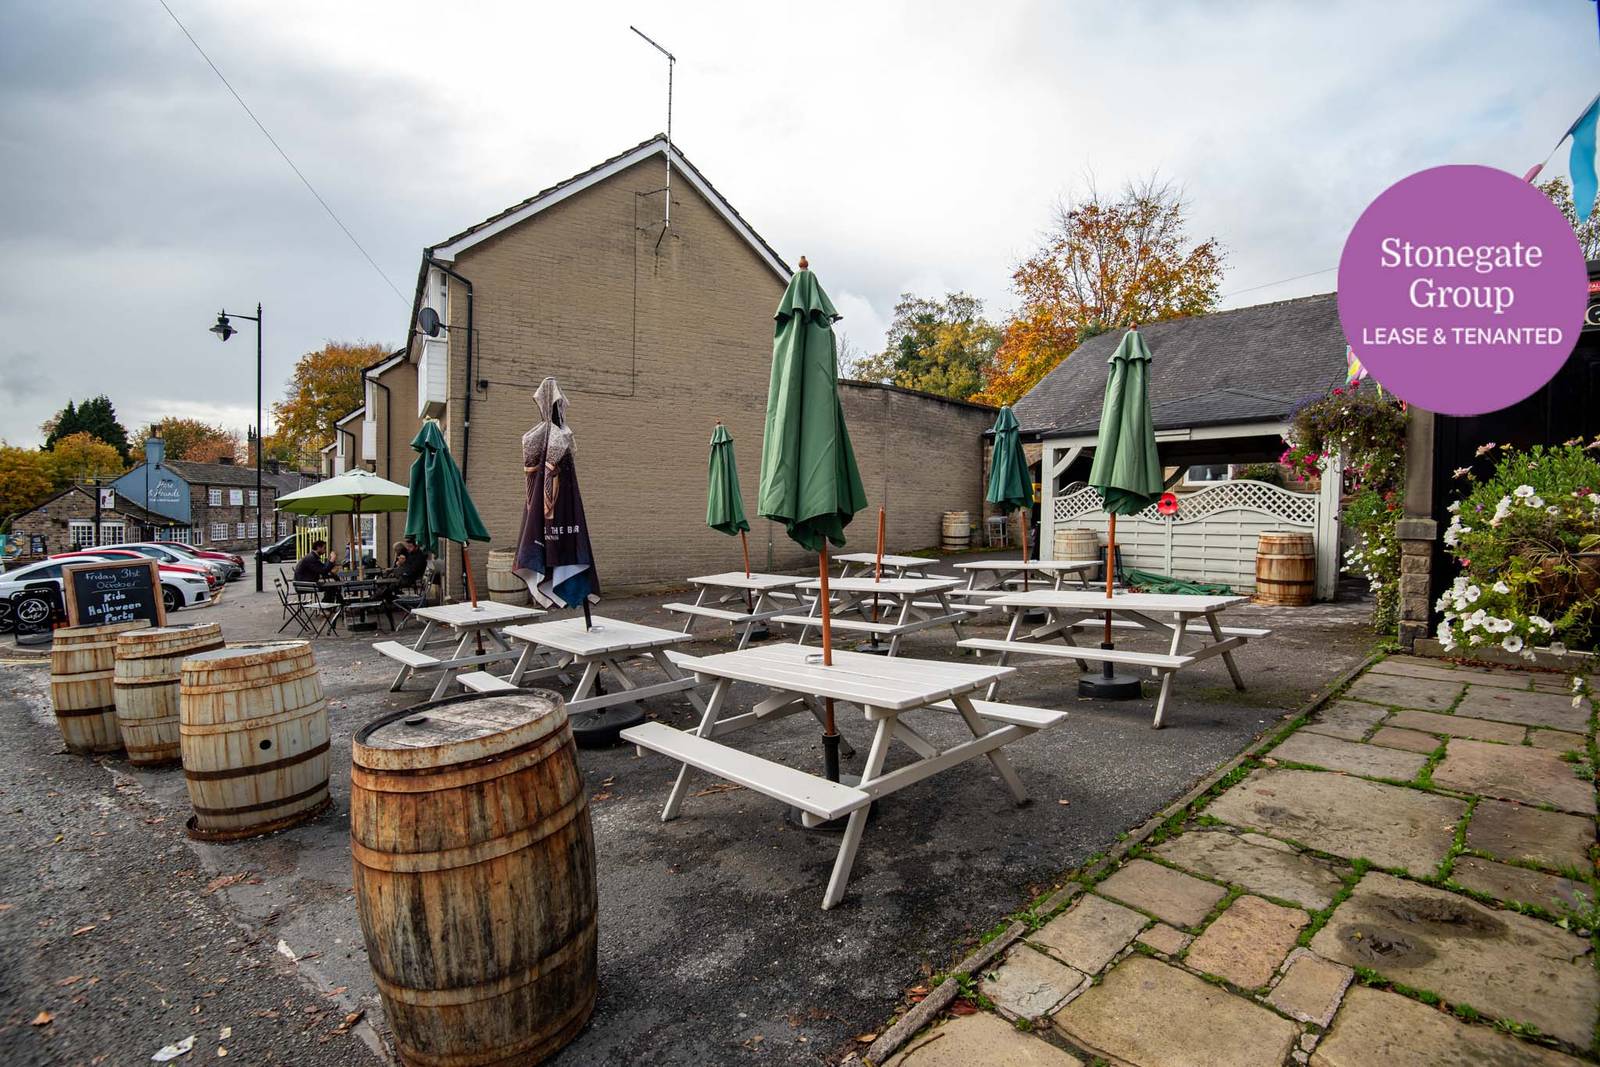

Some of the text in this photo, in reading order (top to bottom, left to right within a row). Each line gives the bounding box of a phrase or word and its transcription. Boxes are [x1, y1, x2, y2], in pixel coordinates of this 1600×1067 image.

[551, 526, 564, 535] THE
[85, 572, 117, 582] Friday
[96, 581, 137, 590] October
[103, 590, 126, 602] Kids
[88, 602, 142, 616] Halloween
[104, 611, 134, 624] Party
